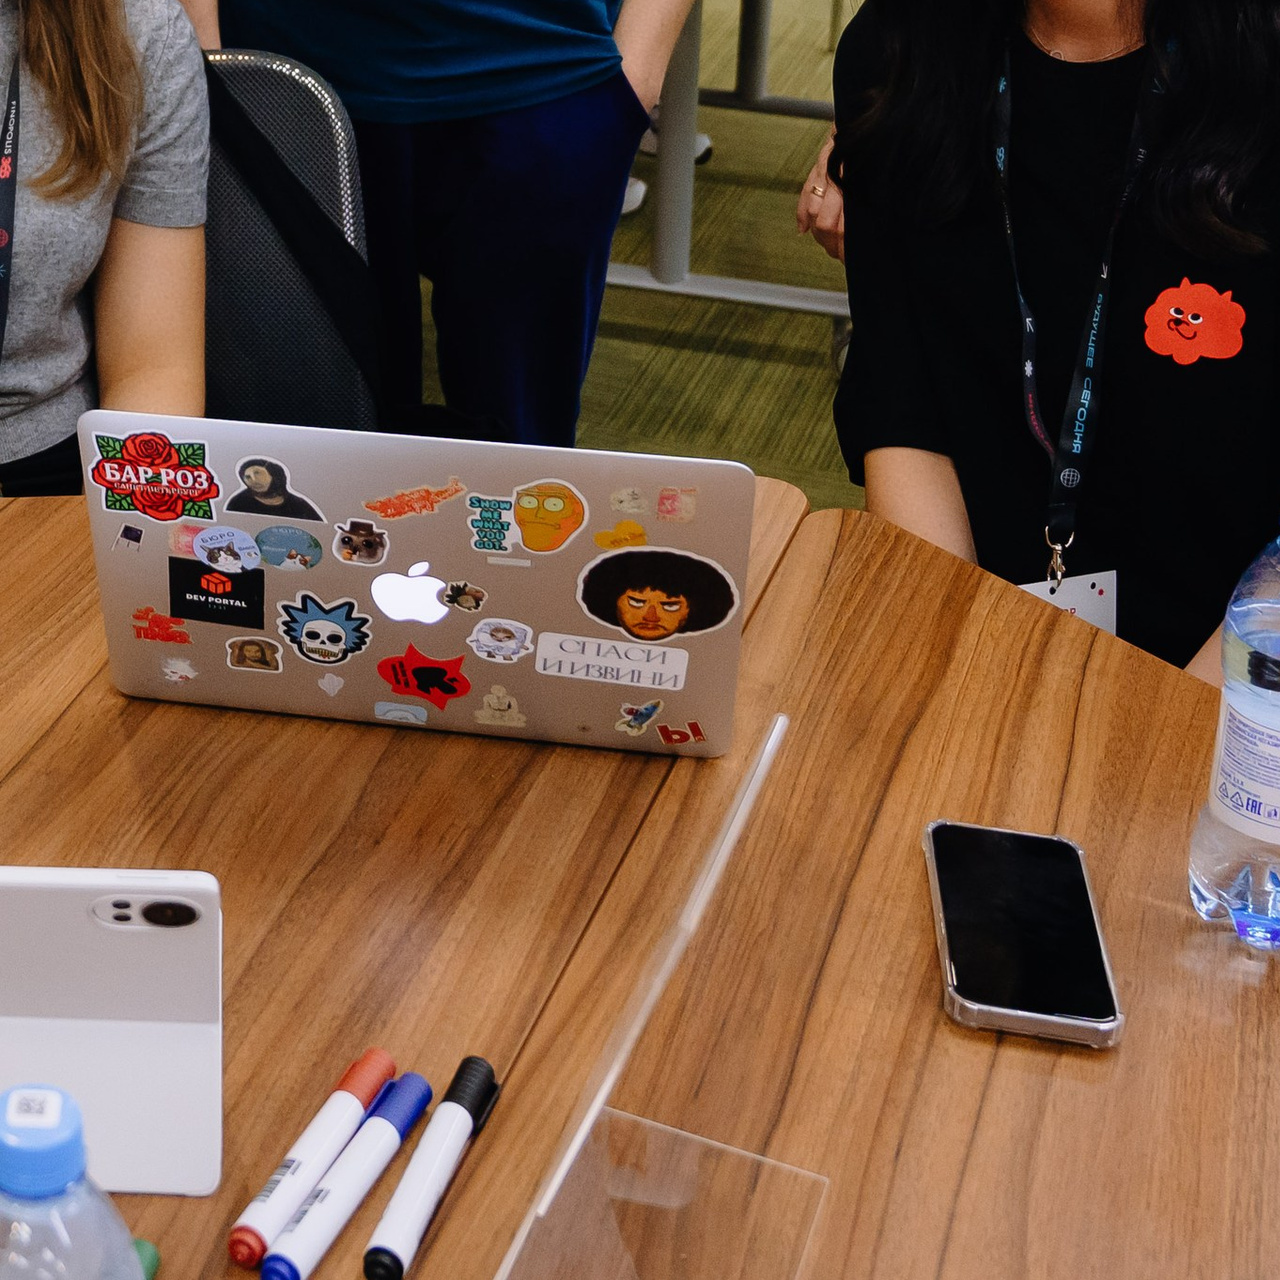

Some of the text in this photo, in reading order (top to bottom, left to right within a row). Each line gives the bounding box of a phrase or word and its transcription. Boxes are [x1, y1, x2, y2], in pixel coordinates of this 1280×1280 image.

[3, 100, 17, 155] FINOPOLIS
[1072, 293, 1104, 455] БУДУЩЕЕ СЕГОДНЯ
[104, 462, 209, 490] БАР РОЗ
[469, 496, 513, 511] SHOW
[480, 508, 502, 520] ME
[471, 518, 511, 531] WHAT
[200, 531, 235, 544] БЮРО
[476, 529, 506, 541] YOU
[185, 593, 207, 602] DEV
[208, 597, 248, 608] PORTAL
[559, 638, 667, 665] СПАСИ
[543, 657, 679, 688] И ИЗВИНИ
